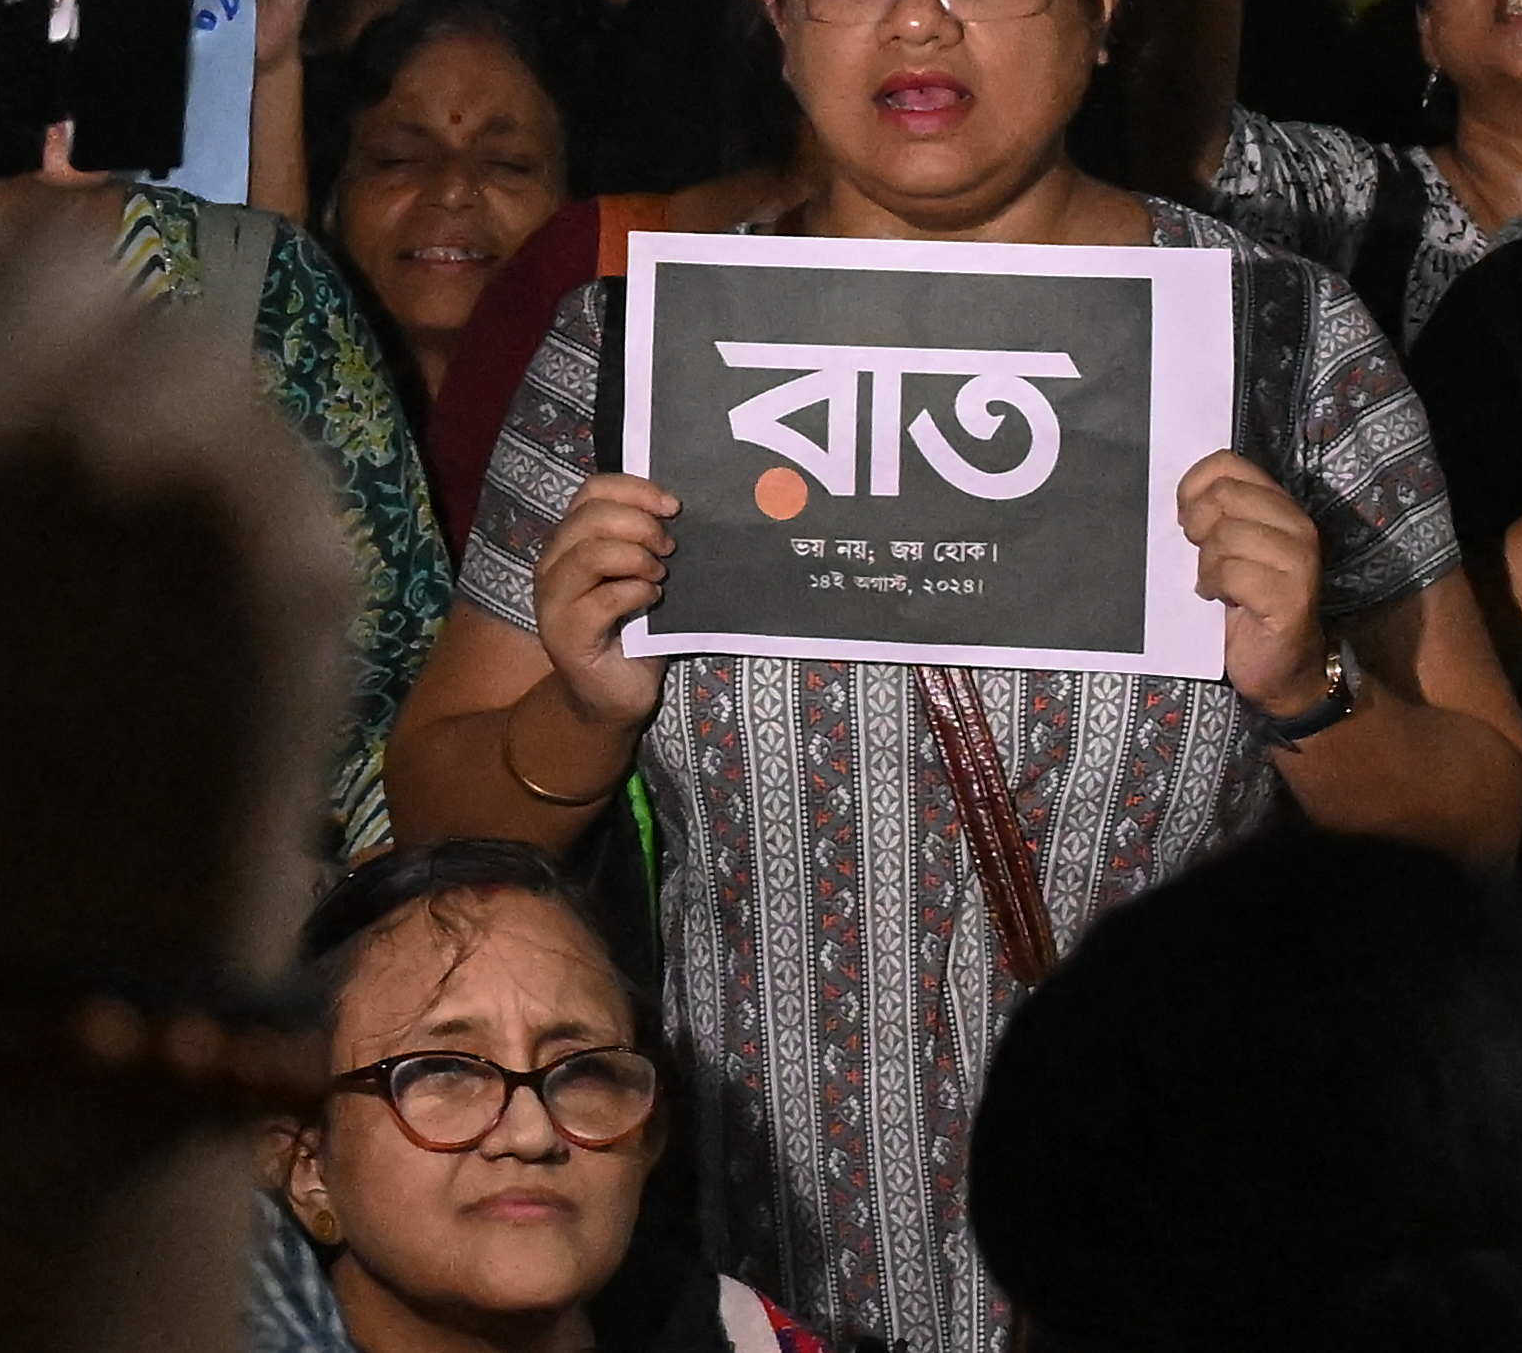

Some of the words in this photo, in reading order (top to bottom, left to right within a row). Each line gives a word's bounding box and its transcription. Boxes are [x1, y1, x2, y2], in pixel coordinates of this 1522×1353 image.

[714, 340, 1083, 521] রাত
[790, 537, 827, 559] ভয়
[834, 539, 875, 566] নয়;
[888, 540, 925, 562] জয়
[809, 570, 846, 591] ১৪ই
